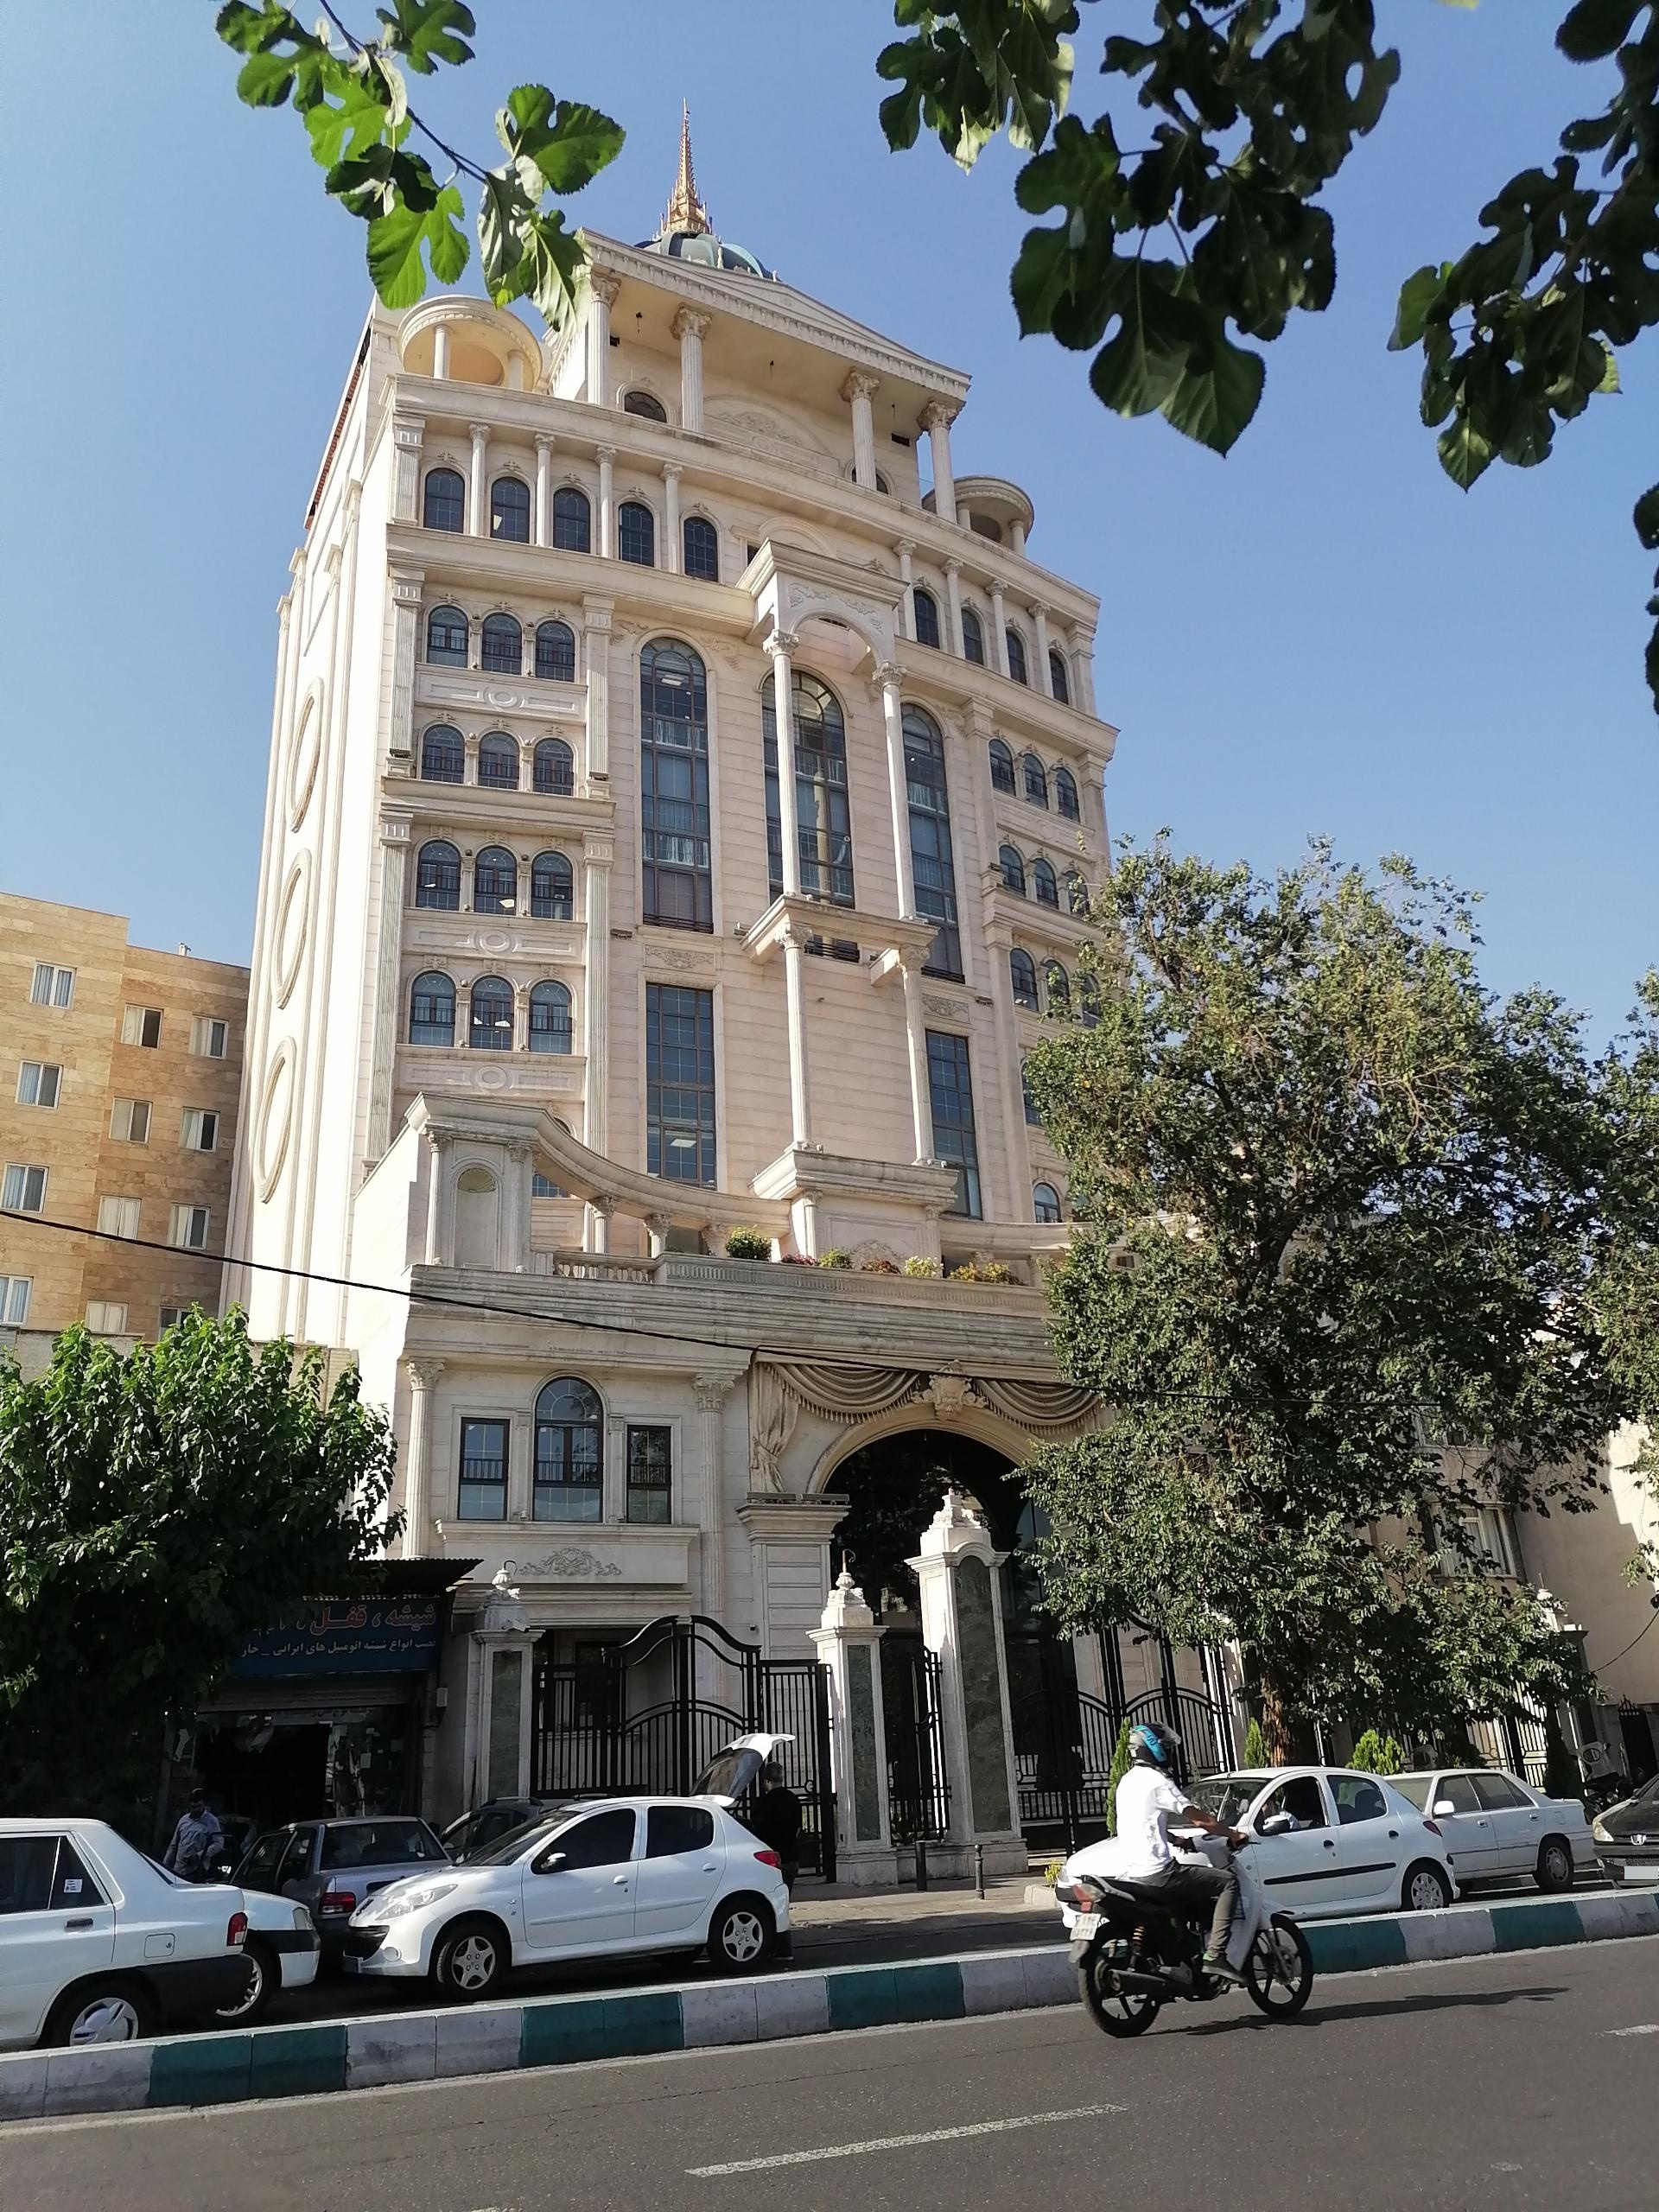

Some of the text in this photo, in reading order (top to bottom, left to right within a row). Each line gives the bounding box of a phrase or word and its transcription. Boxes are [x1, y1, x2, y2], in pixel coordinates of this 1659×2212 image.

[310, 1605, 367, 1637] قفل
[305, 1642, 326, 1656] های
[389, 1638, 413, 1652] انواع
